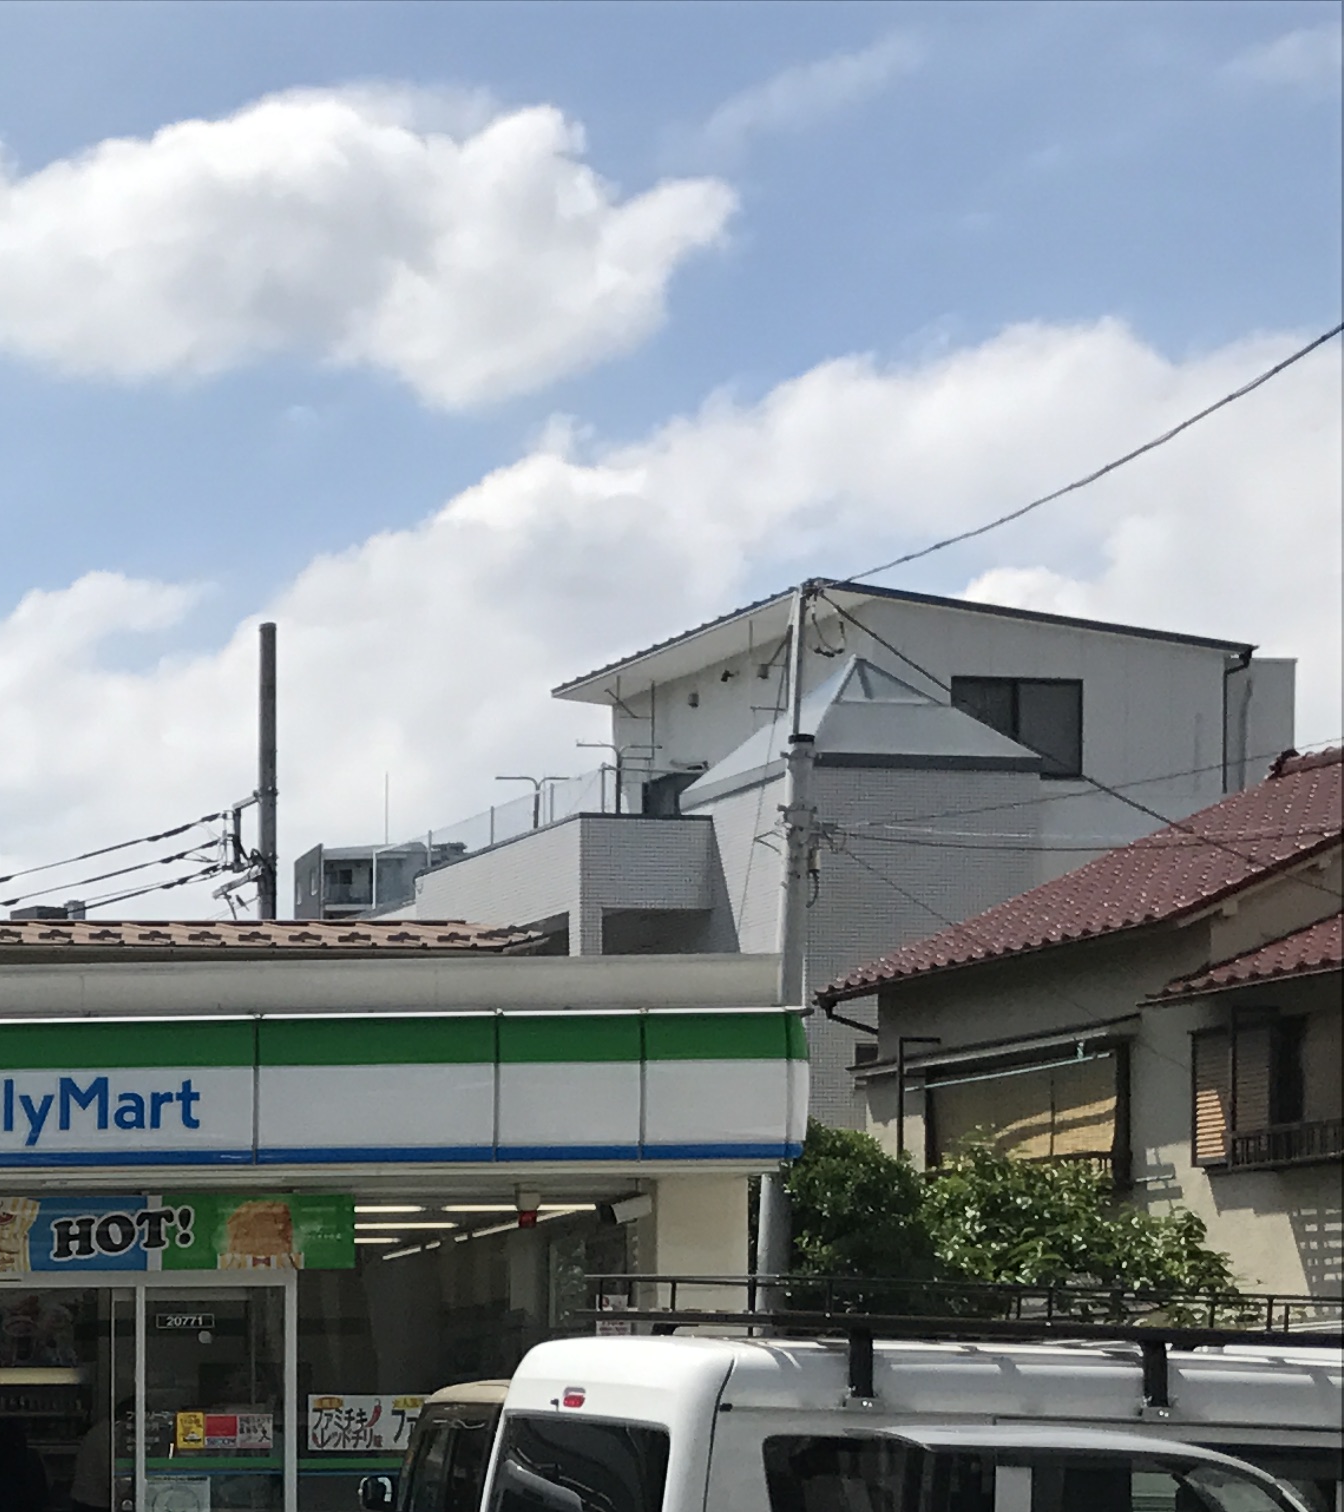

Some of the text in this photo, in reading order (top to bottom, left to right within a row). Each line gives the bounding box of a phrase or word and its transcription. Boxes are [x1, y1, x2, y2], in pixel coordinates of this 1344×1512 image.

[51, 1206, 195, 1261] HOT!
[166, 1316, 204, 1326] 20771
[312, 1407, 368, 1431] ファミチキ
